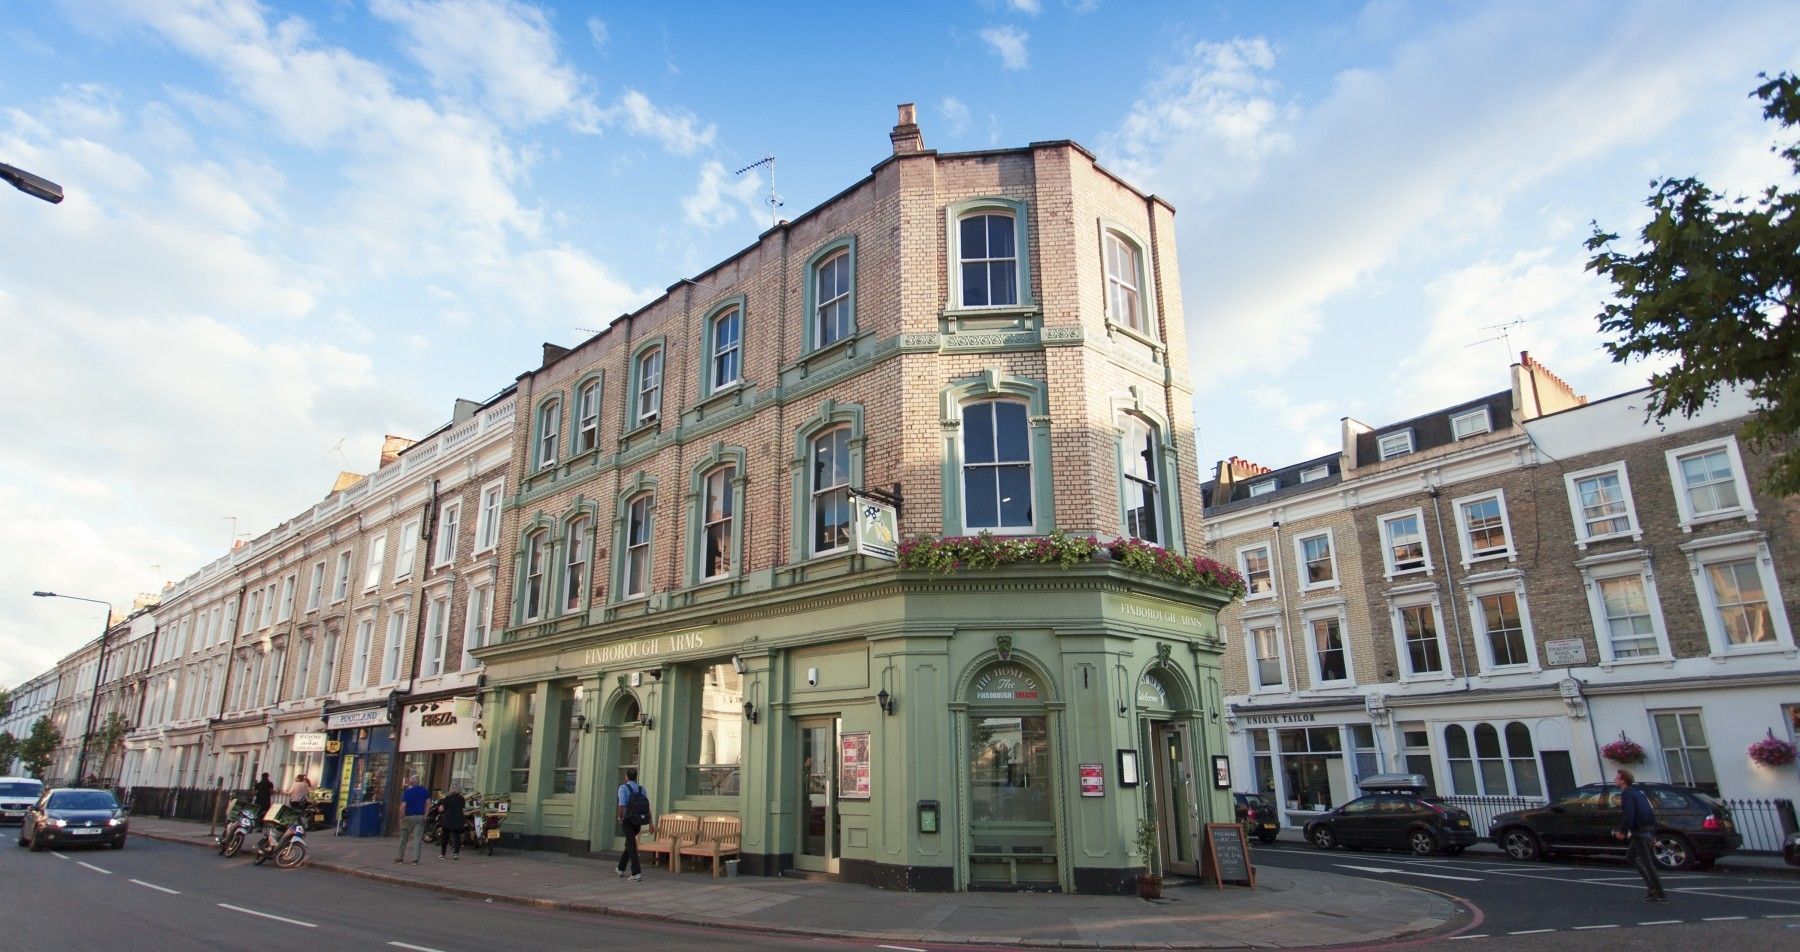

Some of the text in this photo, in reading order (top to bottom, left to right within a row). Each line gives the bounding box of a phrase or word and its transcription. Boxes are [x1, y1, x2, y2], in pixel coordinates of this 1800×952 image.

[1121, 603, 1202, 627] FINBOROUGH ARMS
[585, 632, 704, 665] FINBOROUGH ARMS
[976, 667, 1038, 690] THE HOME OF
[997, 678, 1016, 689] The
[977, 691, 1012, 699] FINBOROUGH
[1247, 713, 1315, 724] UNIQUE TAILOR
